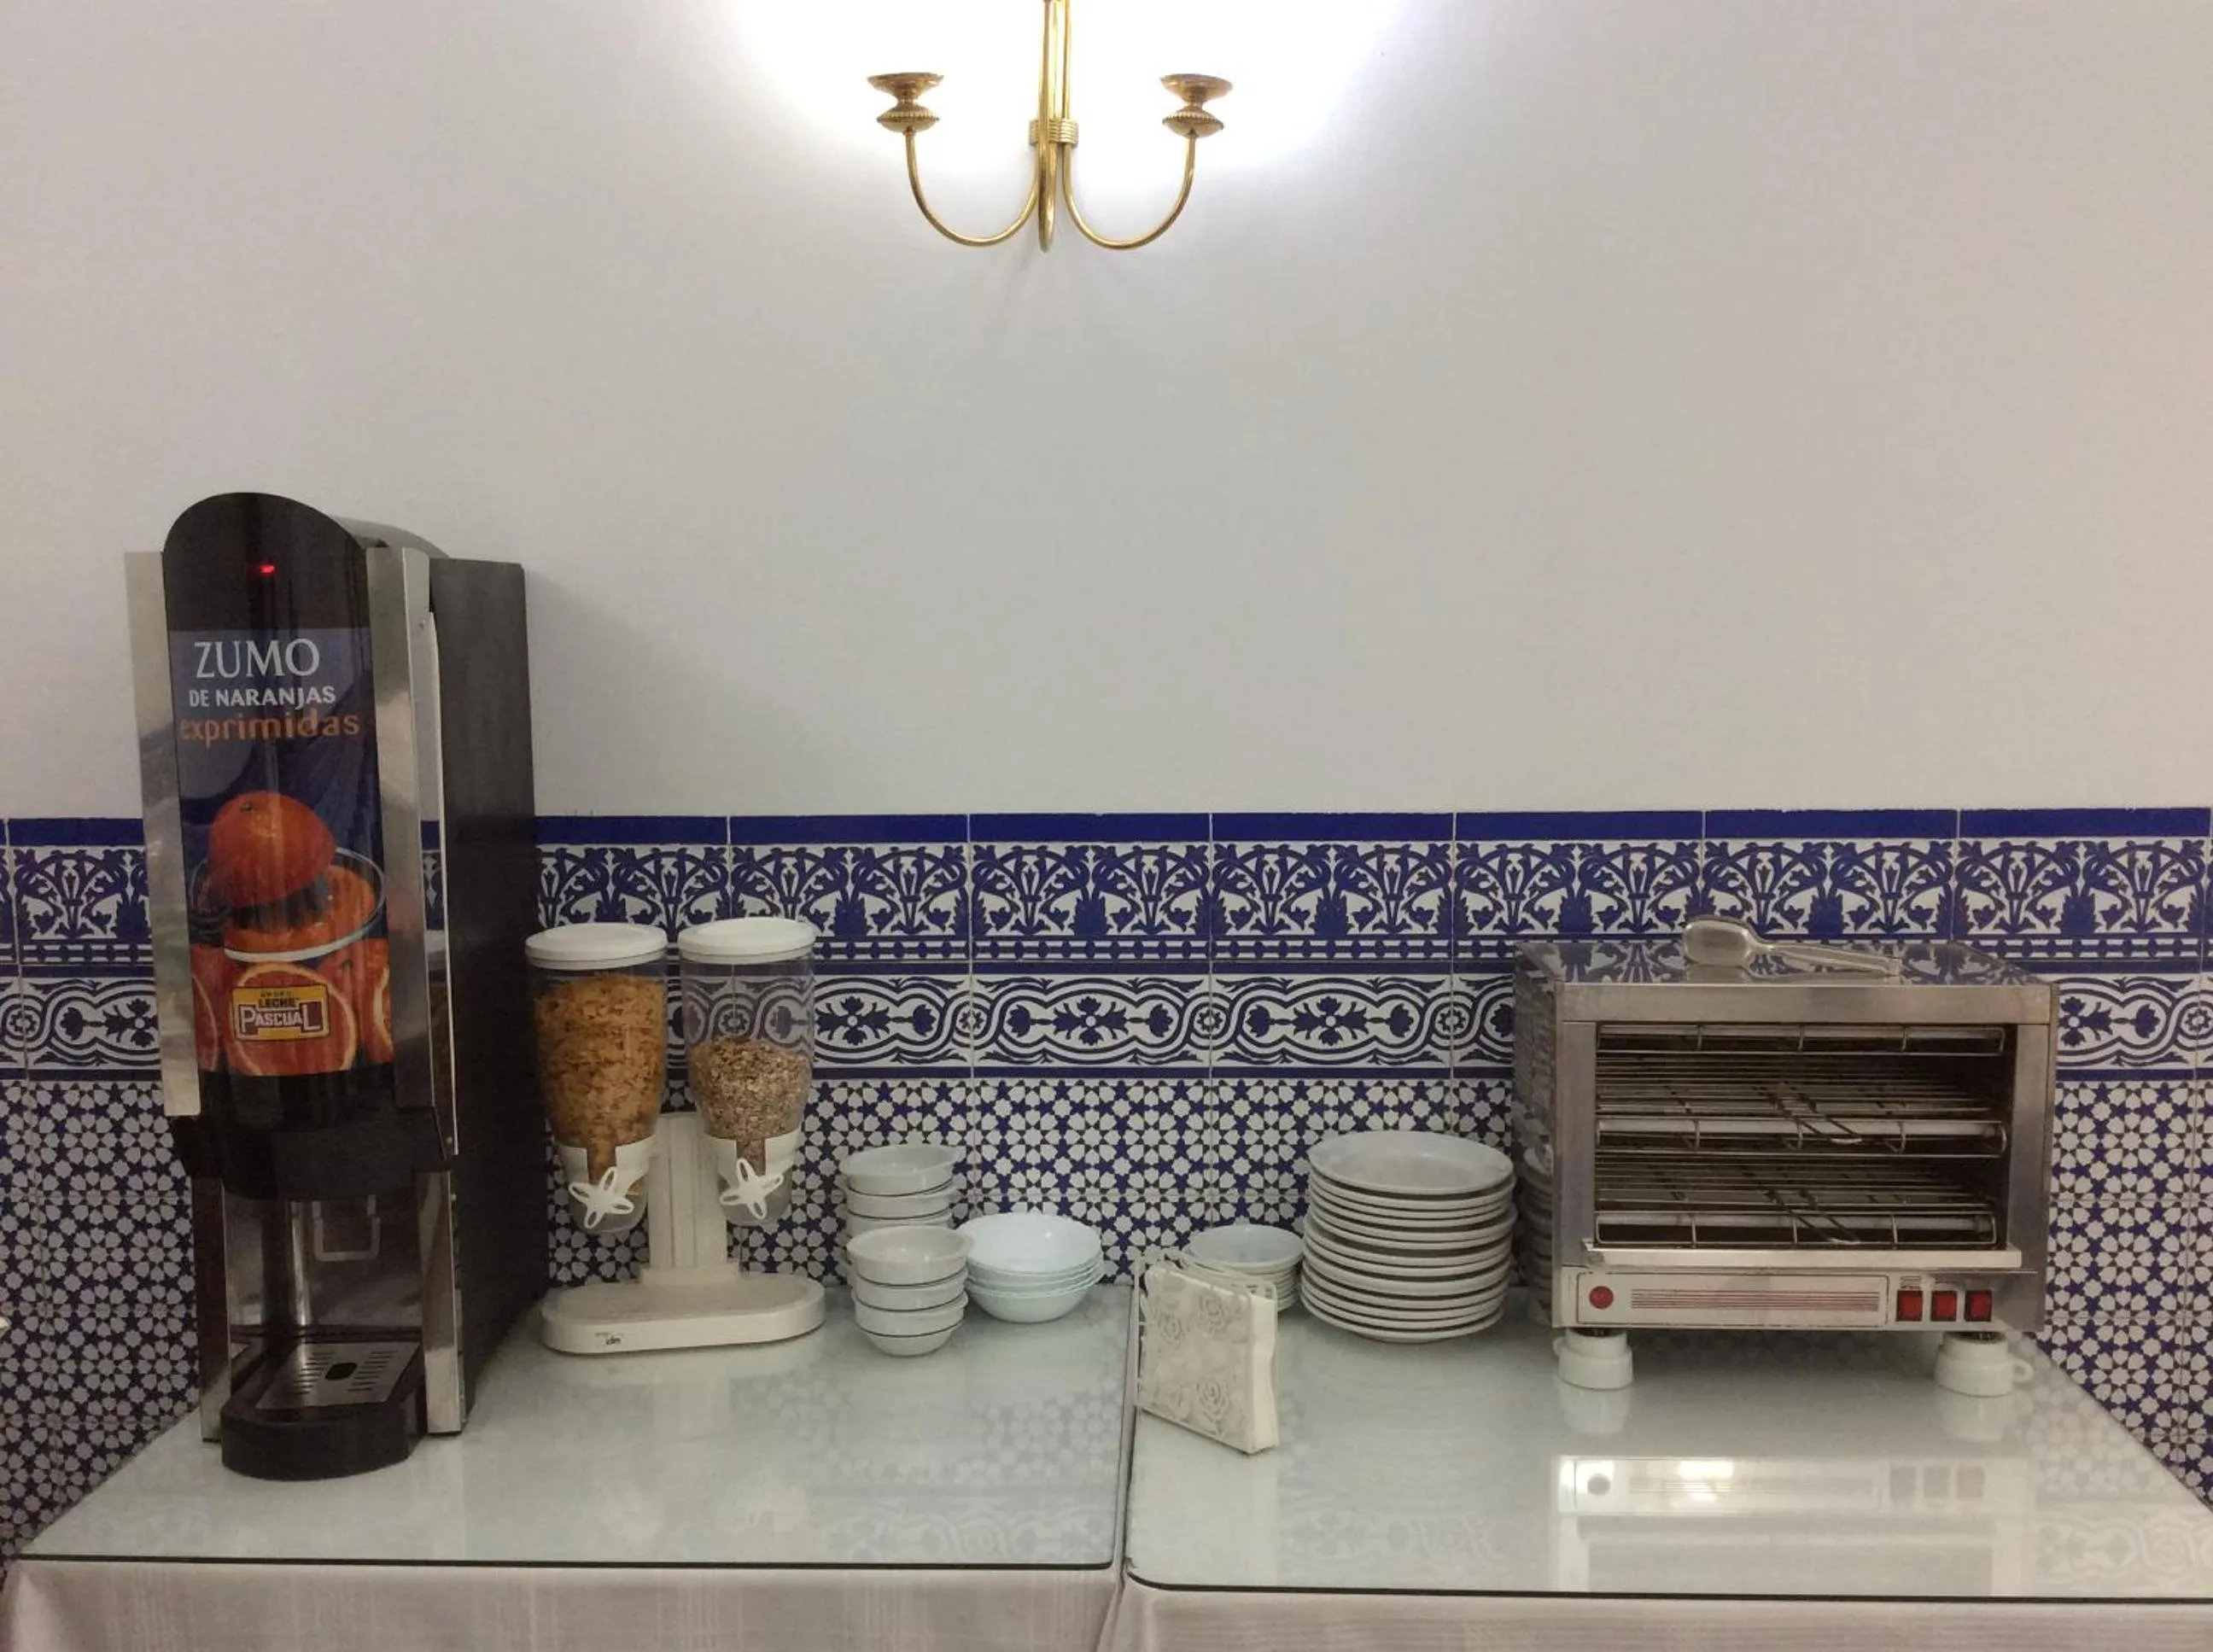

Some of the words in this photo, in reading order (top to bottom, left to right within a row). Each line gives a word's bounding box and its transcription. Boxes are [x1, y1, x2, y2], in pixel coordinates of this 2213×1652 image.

[195, 639, 320, 678] ZUMO
[189, 688, 210, 707] DE
[216, 686, 336, 709] NARANJAS
[179, 707, 359, 749] exprimidas
[239, 1003, 321, 1033] PASCUAL
